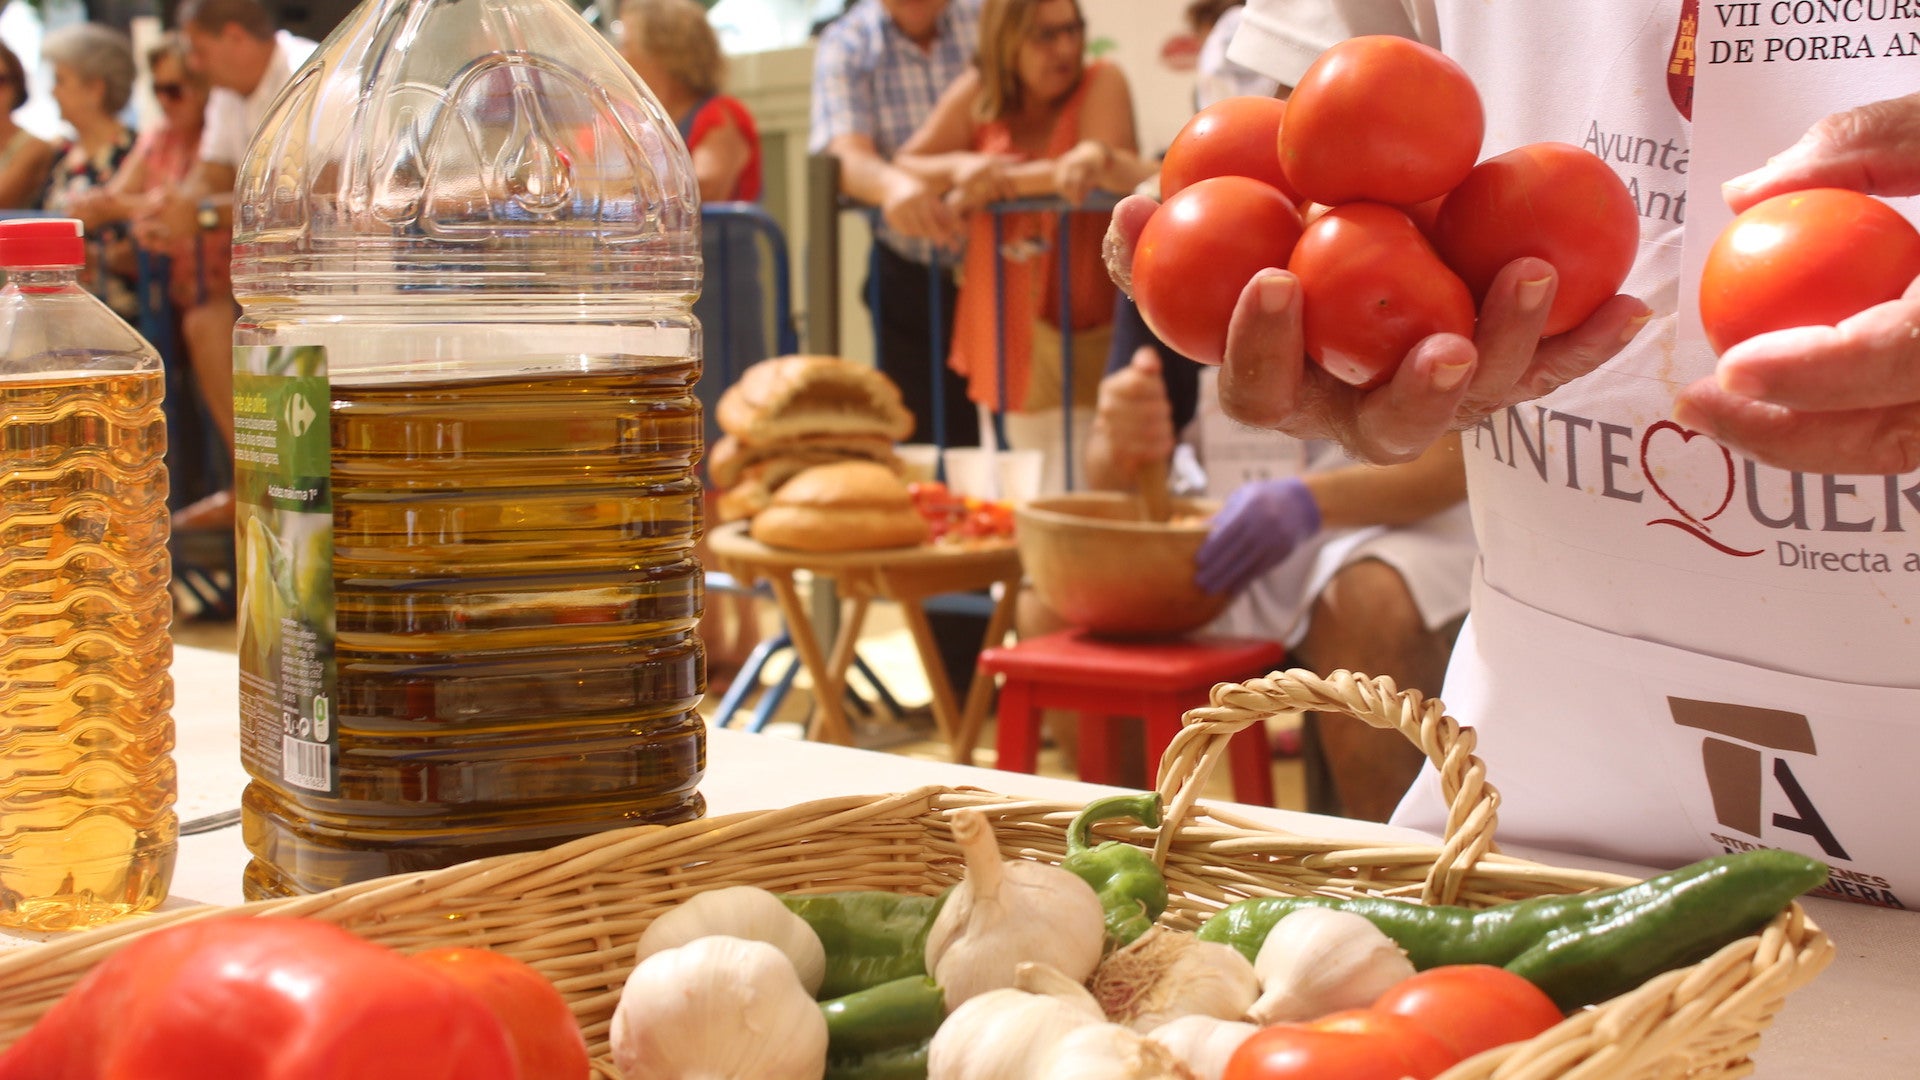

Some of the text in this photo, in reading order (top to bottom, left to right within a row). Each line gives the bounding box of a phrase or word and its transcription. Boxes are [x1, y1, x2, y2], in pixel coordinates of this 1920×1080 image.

[1714, 3, 1761, 27] VII
[1709, 40, 1754, 64] DE
[1763, 35, 1875, 62] PORRA
[1776, 540, 1920, 573] Directa a
